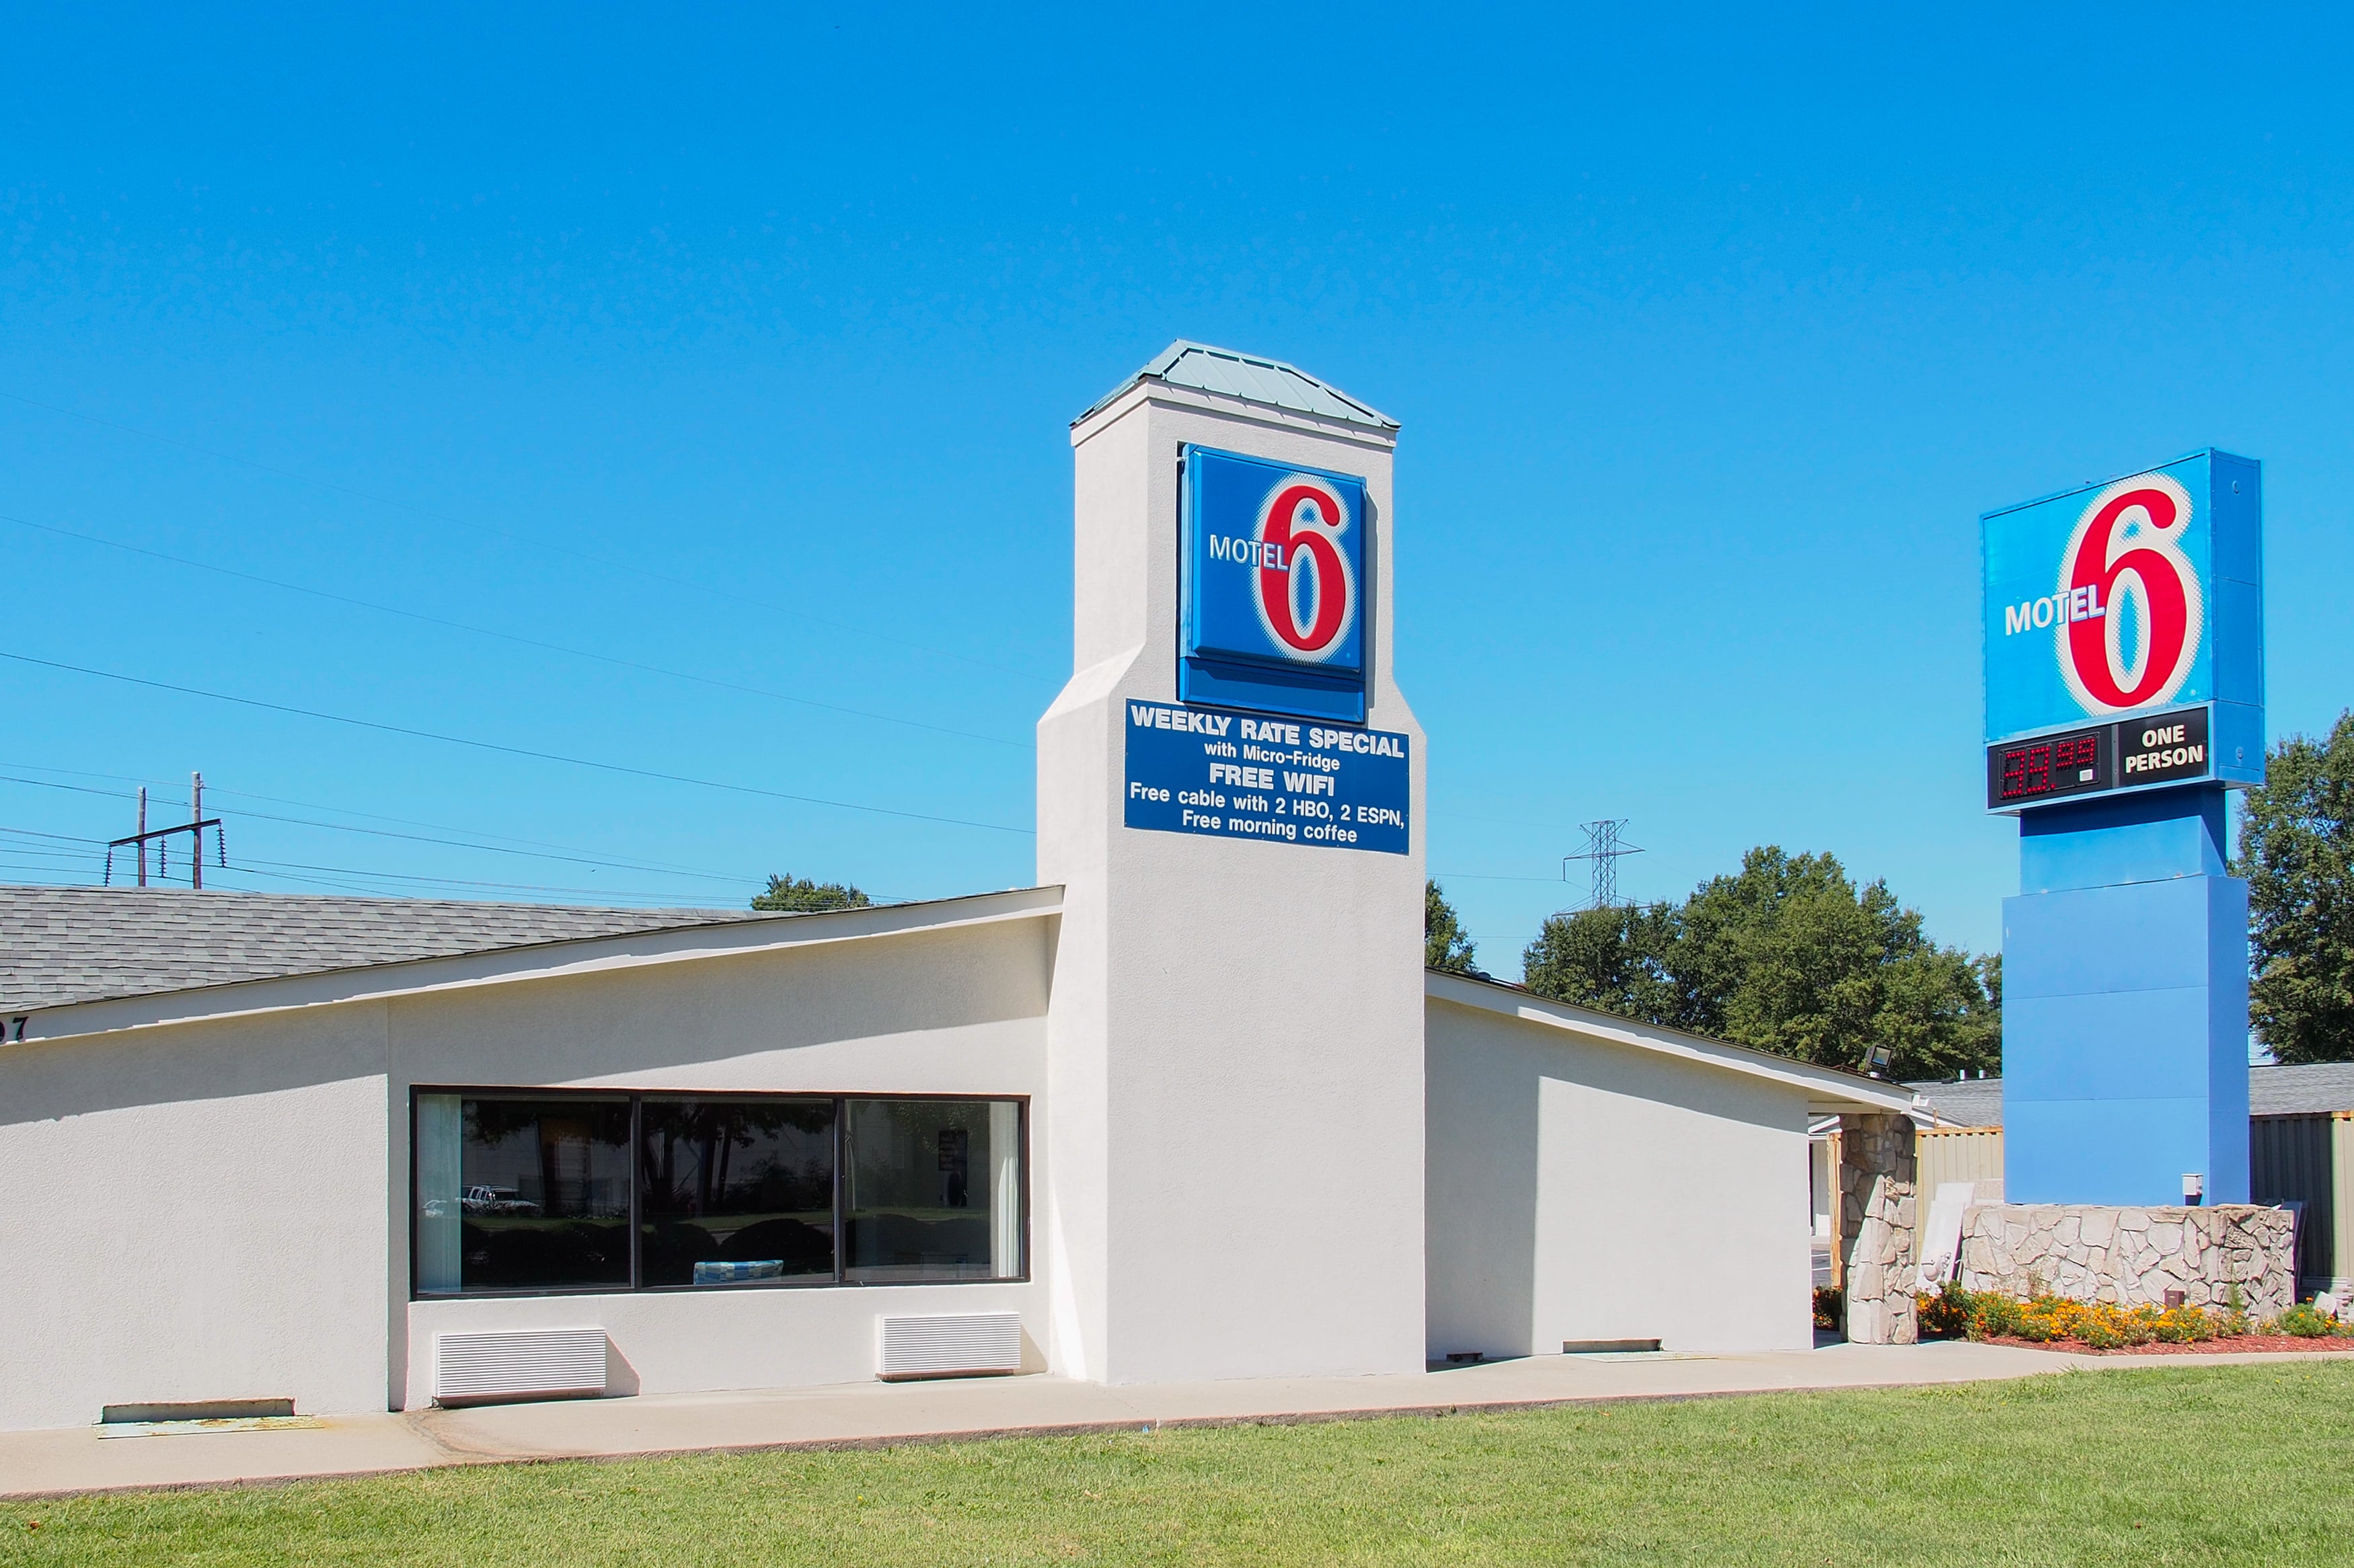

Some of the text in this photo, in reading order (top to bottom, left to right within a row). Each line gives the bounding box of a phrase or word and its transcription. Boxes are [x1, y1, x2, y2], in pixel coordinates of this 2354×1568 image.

[1209, 483, 1346, 652] MOTEL 6
[2004, 488, 2188, 708] MOTEL 6
[1131, 705, 1405, 758] WEEKLY RATE SPECIAL
[2141, 724, 2185, 748] ONE
[1204, 742, 1340, 771] with Micro-Fridge
[2125, 744, 2203, 773] PERSON
[1209, 762, 1334, 797] FREE WIFI
[1130, 781, 1405, 830] Free cable with 2 HBO, 2 ESPN,
[1182, 809, 1358, 843] Free morning coffee
